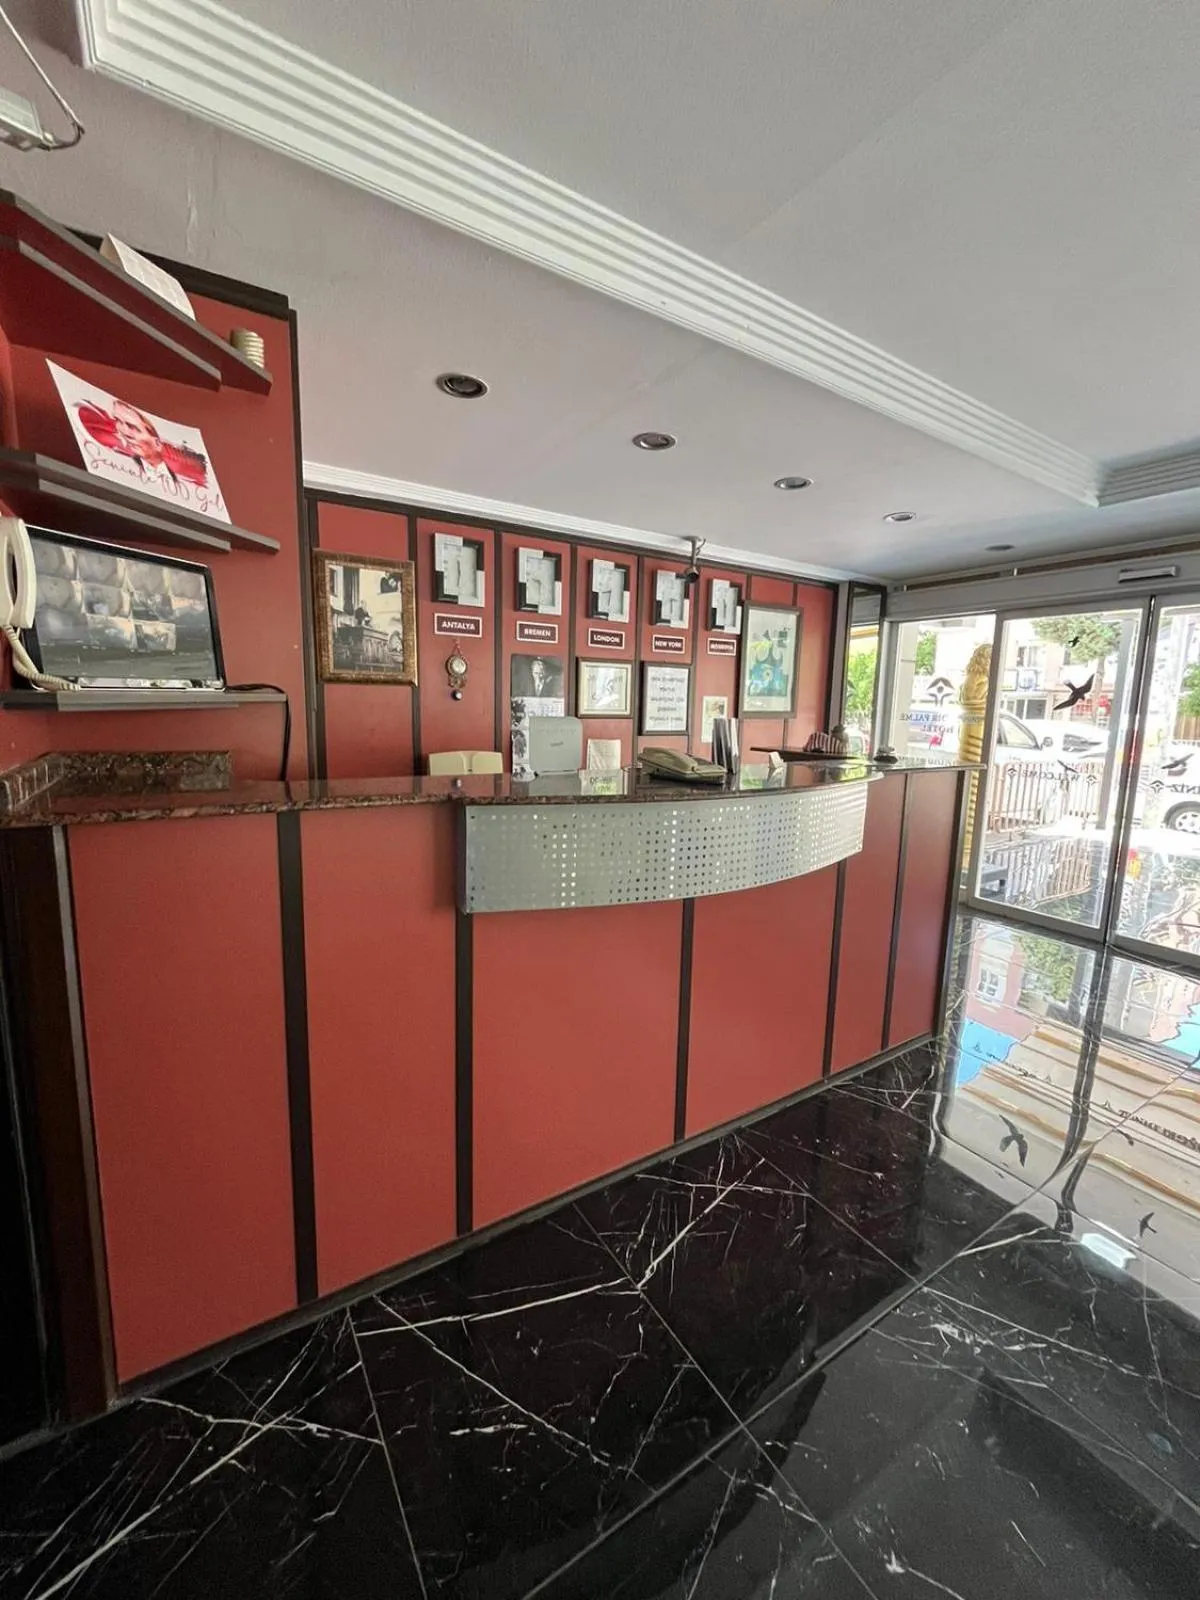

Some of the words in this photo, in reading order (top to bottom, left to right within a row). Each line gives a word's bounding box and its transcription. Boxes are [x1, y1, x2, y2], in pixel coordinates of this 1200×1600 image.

[441, 620, 476, 631] ANTALYA
[524, 628, 551, 637] BREMEN
[593, 634, 620, 644] LONDON
[655, 640, 667, 648] NEW
